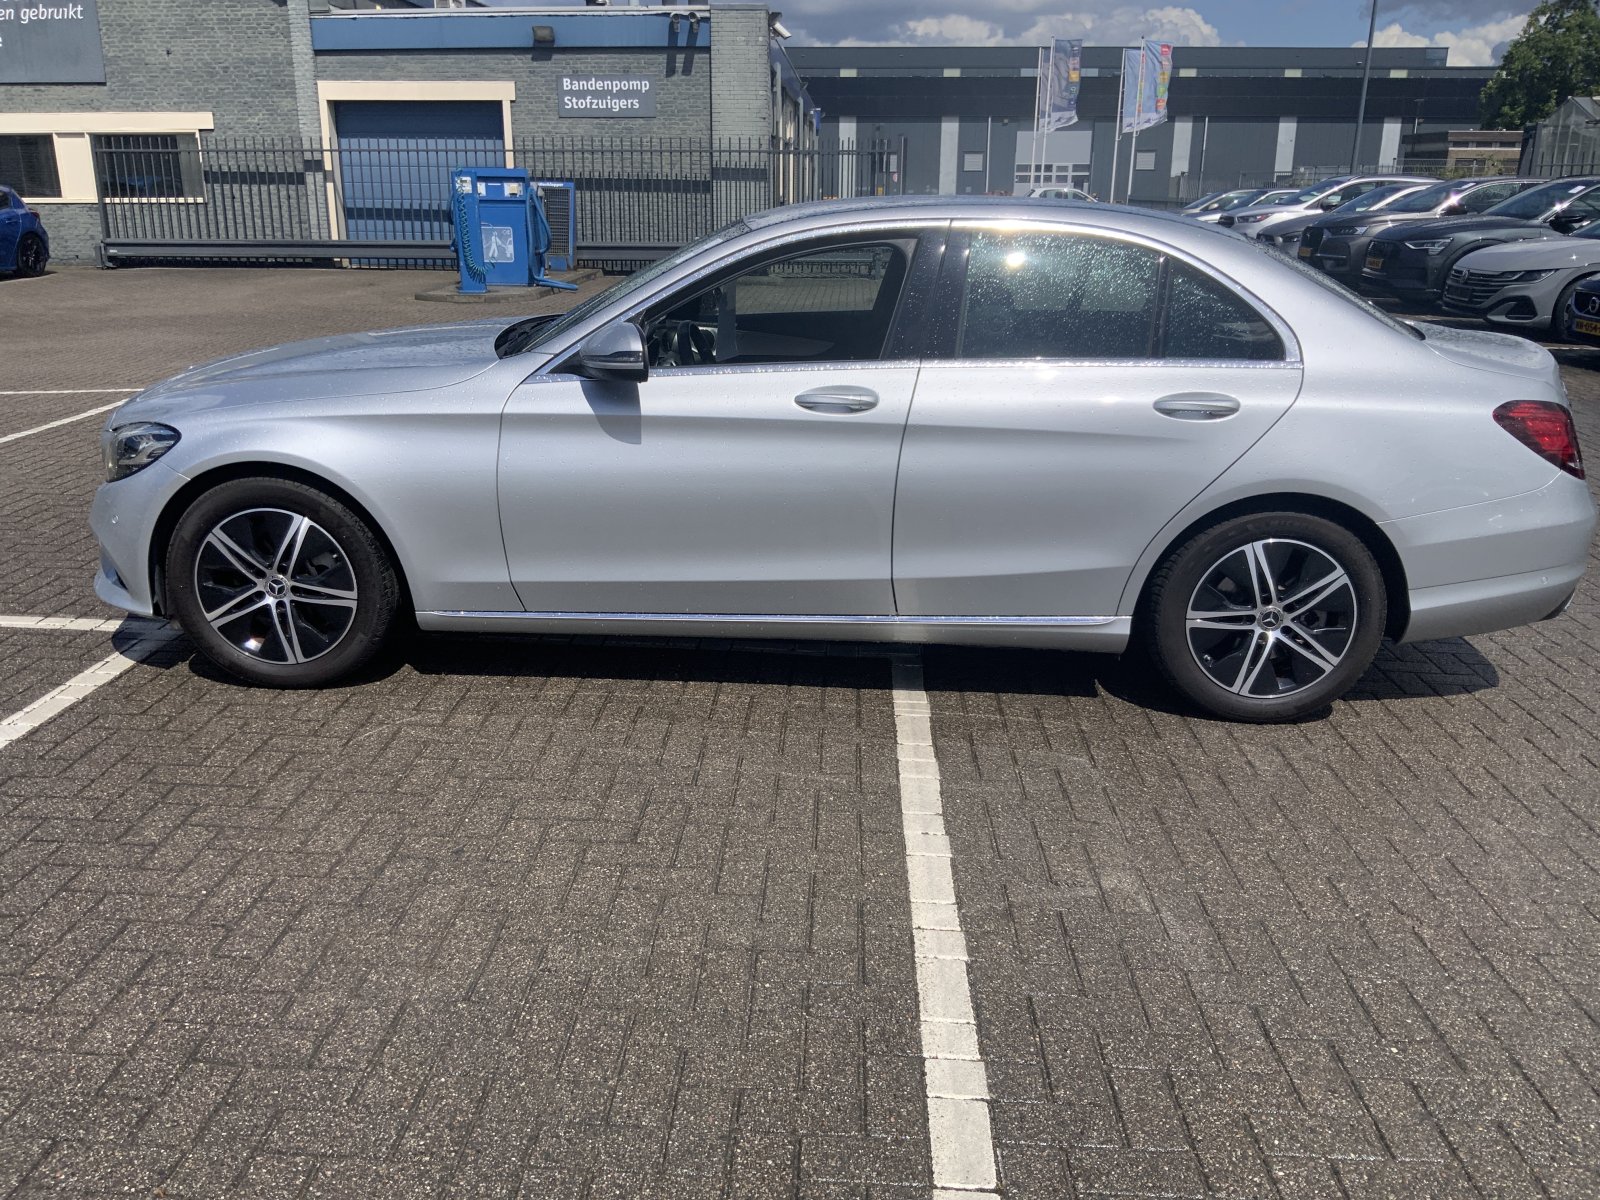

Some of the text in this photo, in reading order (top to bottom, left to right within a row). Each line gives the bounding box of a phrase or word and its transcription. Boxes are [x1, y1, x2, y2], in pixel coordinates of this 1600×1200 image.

[20, 3, 84, 24] gebruikt
[563, 77, 650, 93] Bandenpomp
[564, 95, 640, 112] Stofzuigers
